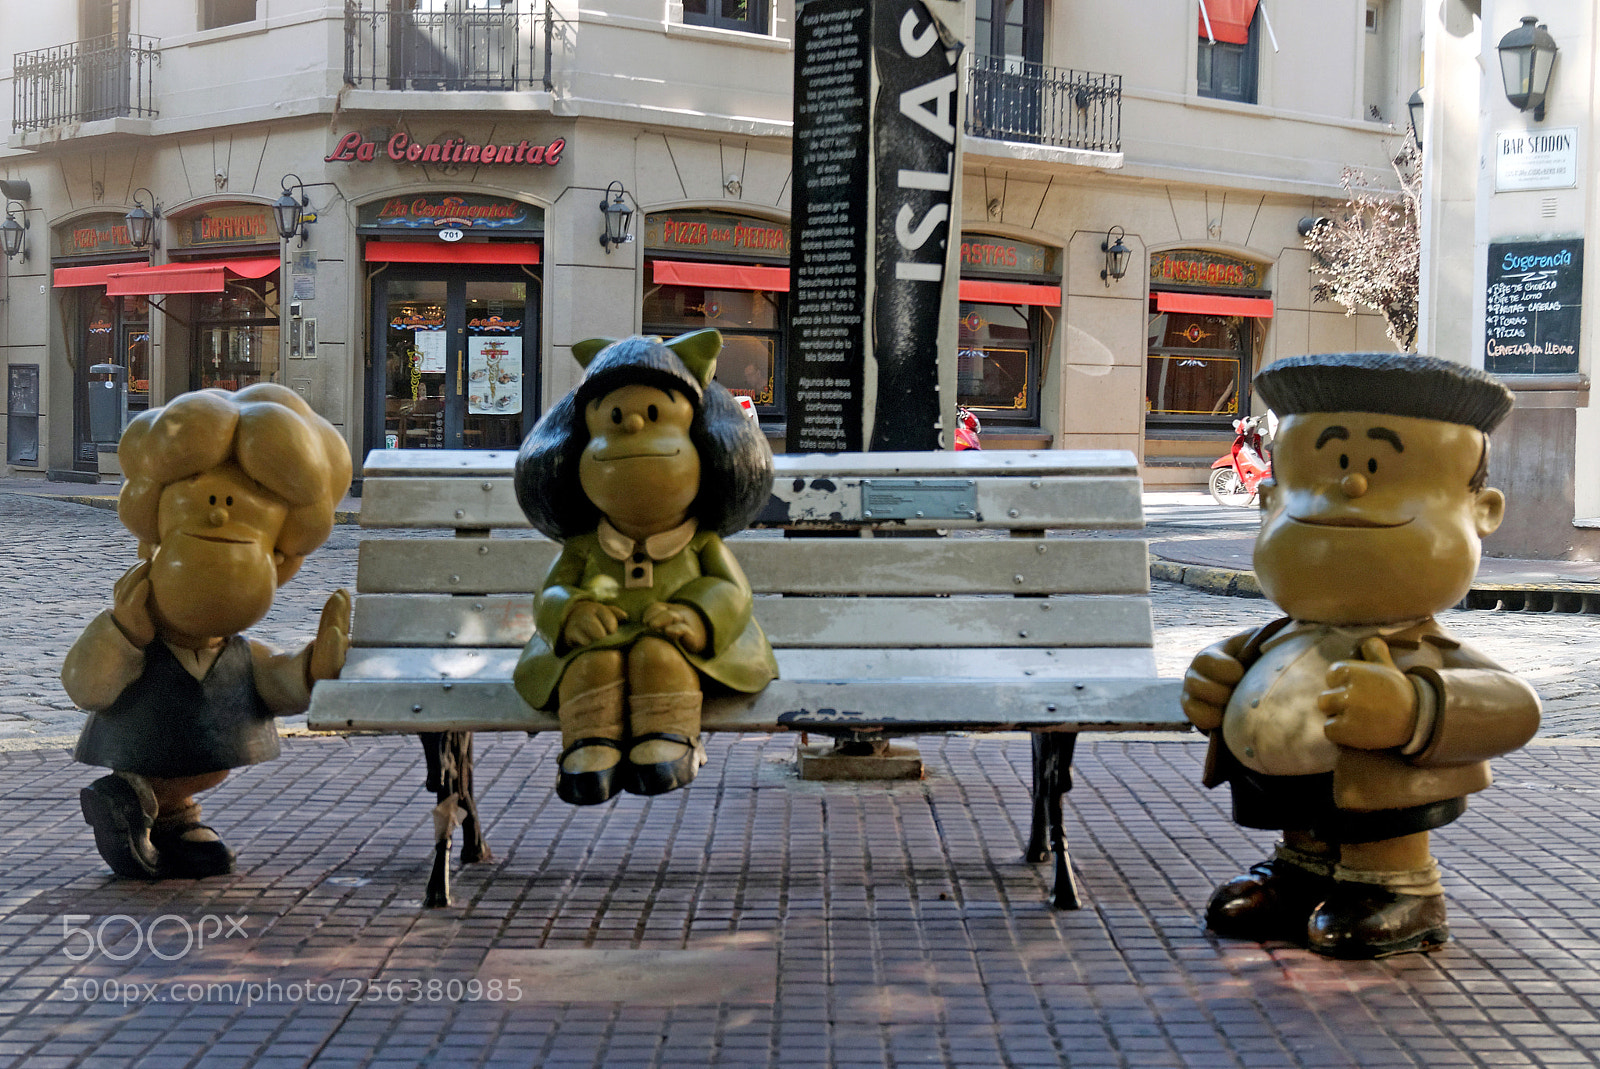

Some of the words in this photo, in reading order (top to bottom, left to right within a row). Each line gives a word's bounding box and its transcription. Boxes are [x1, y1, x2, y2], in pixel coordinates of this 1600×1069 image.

[325, 131, 374, 162] La
[387, 132, 567, 167] Continental
[1503, 138, 1524, 155] BAR
[1528, 134, 1571, 153] SEDDON
[377, 200, 408, 217] La
[411, 198, 519, 218] Continental
[202, 213, 267, 239] EMPANADAS
[444, 231, 459, 239] 701
[663, 218, 708, 245] PIZZA
[734, 221, 785, 249] PIEDRA
[73, 227, 98, 248] PIZZA
[960, 242, 1017, 266] ASTAS
